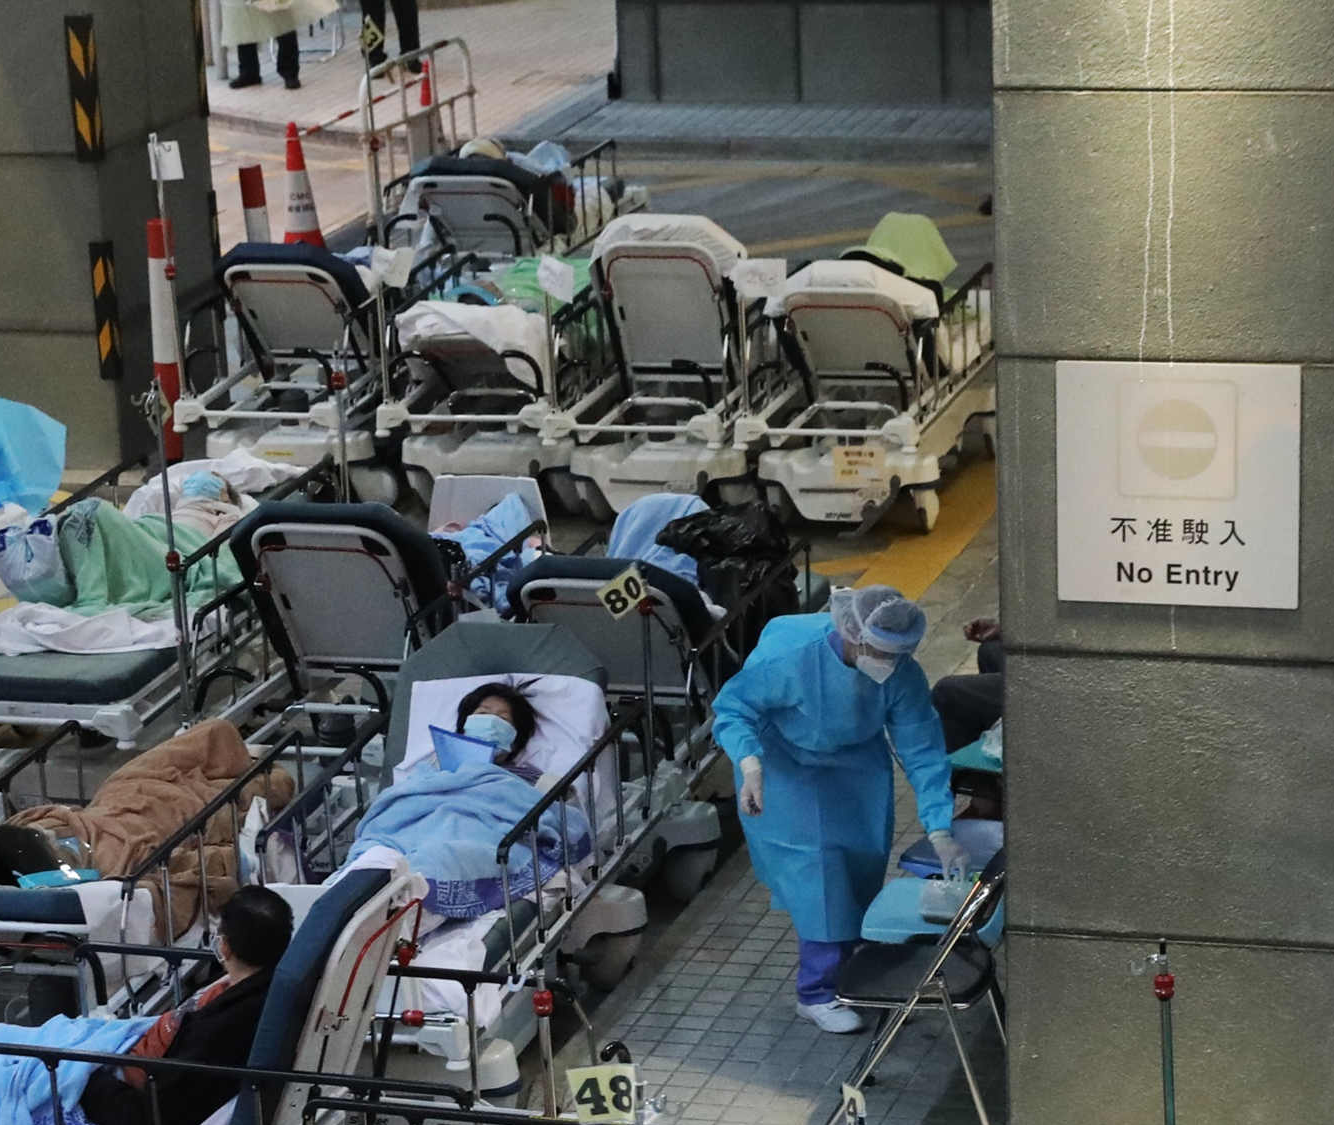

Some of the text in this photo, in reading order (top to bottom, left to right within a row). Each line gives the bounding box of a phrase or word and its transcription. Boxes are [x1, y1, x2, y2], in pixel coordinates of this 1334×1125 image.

[1110, 517, 1246, 546] 不准駛入
[1117, 561, 1239, 592] No Entry
[604, 576, 641, 614] 80
[575, 1074, 633, 1116] 48
